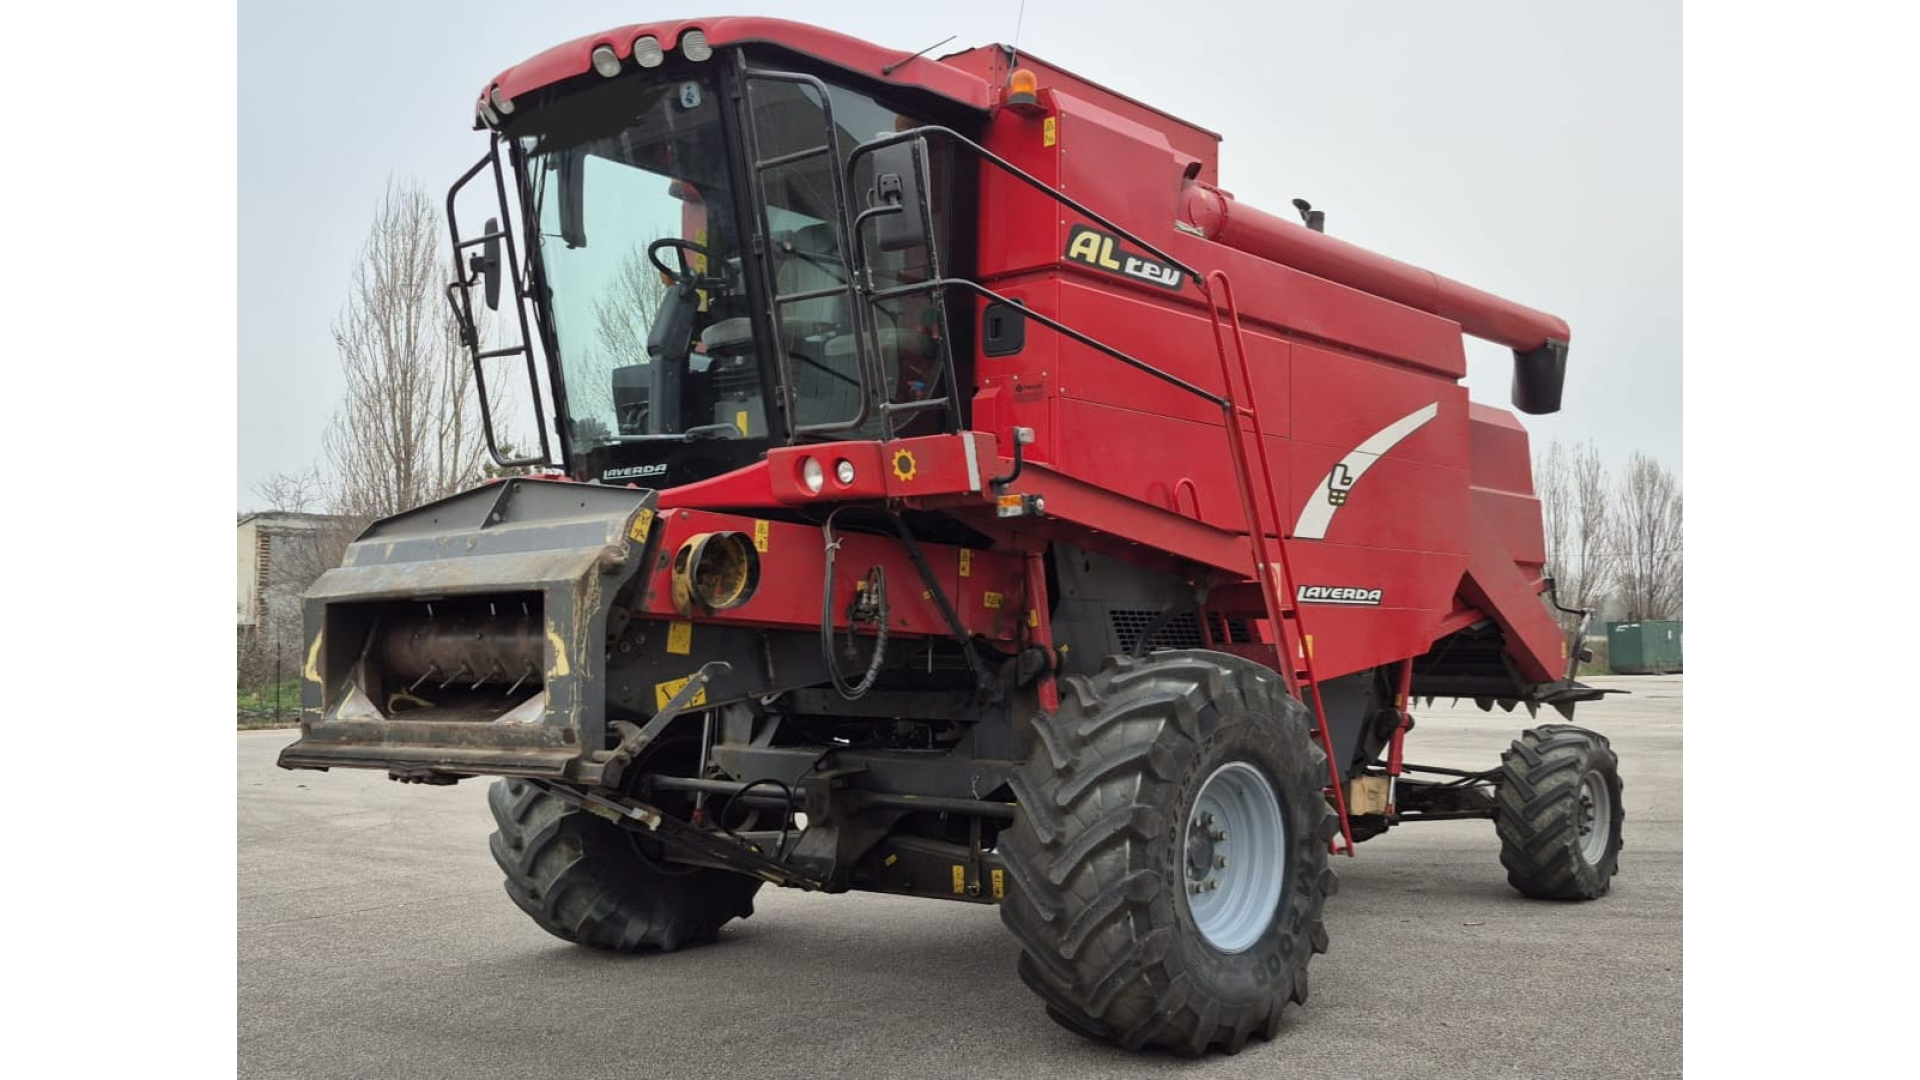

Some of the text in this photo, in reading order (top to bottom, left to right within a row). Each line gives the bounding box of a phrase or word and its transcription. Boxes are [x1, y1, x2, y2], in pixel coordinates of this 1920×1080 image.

[1069, 231, 1120, 271] AL
[603, 463, 668, 480] LAVERDA
[1297, 585, 1382, 604] LAVERDA
